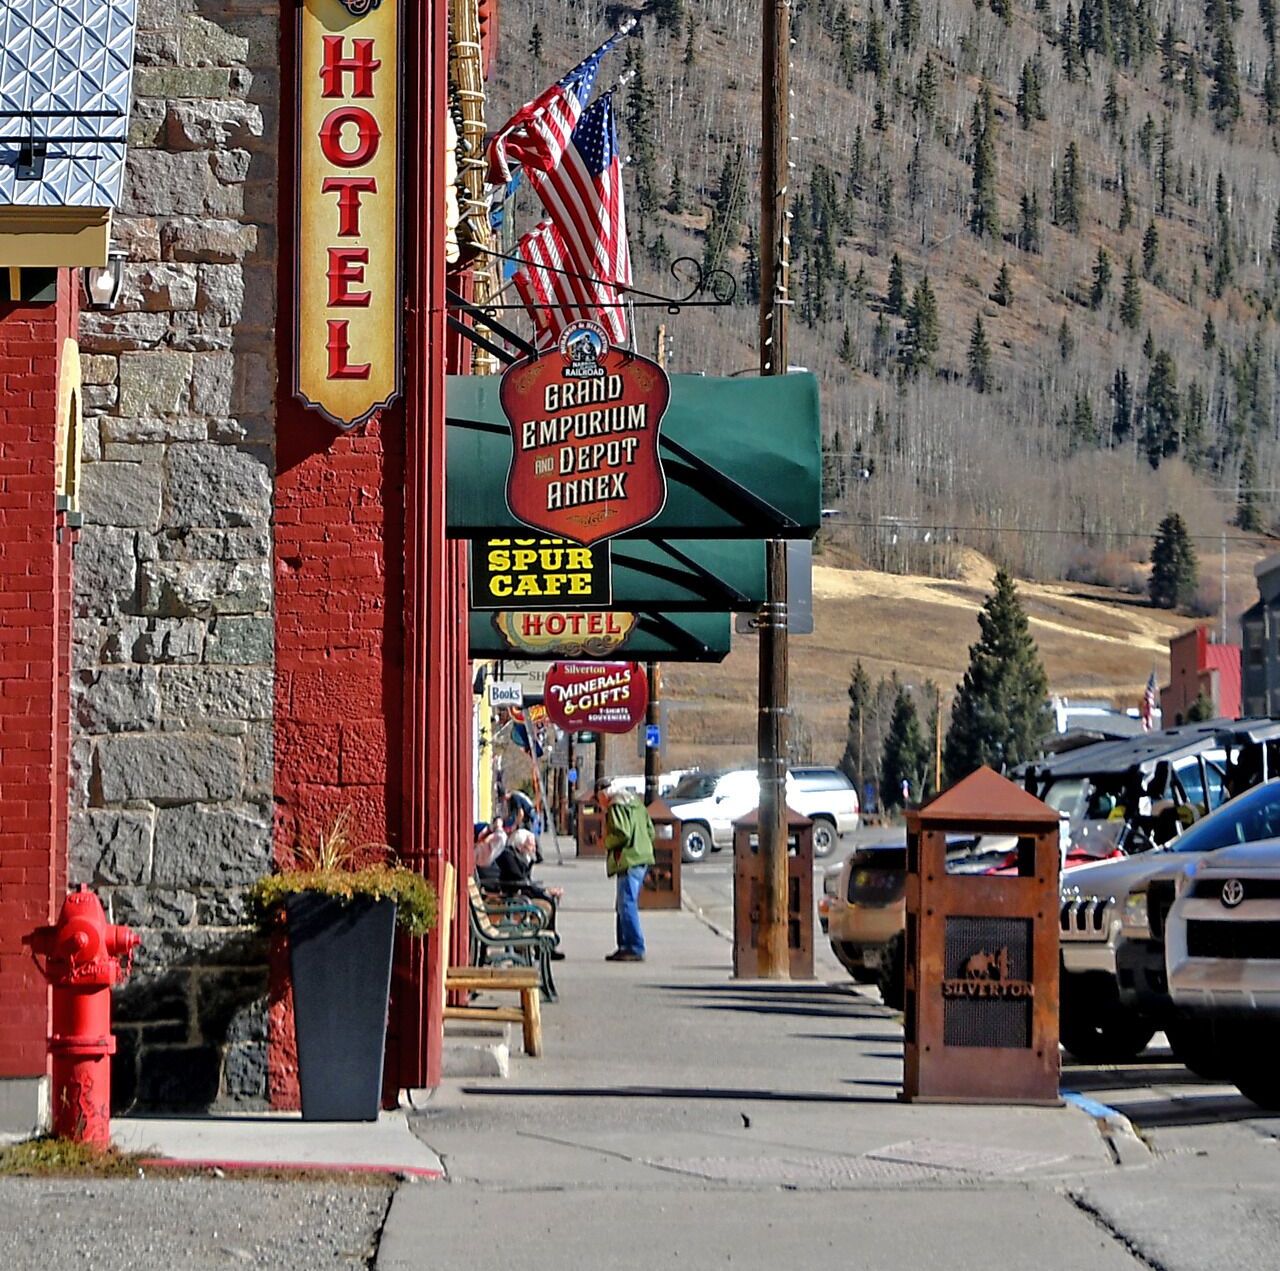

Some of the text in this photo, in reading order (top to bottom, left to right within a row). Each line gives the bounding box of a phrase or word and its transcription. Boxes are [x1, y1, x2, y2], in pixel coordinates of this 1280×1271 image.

[319, 34, 382, 382] HOTEL
[565, 368, 605, 377] RAILROAD
[544, 375, 623, 412] GRAND
[522, 404, 647, 450] EMPORIUM
[534, 437, 638, 477] AND DEPOT
[547, 472, 627, 510] ANNEX
[487, 548, 594, 571] SPUR
[488, 573, 592, 597] CAFE
[521, 612, 622, 636] HOTEL
[564, 664, 606, 674] Silverton
[492, 686, 520, 701] Books
[550, 669, 632, 702] MINERALS
[599, 706, 629, 714] T-SHIRTS
[942, 980, 1035, 998] SILVERTON
